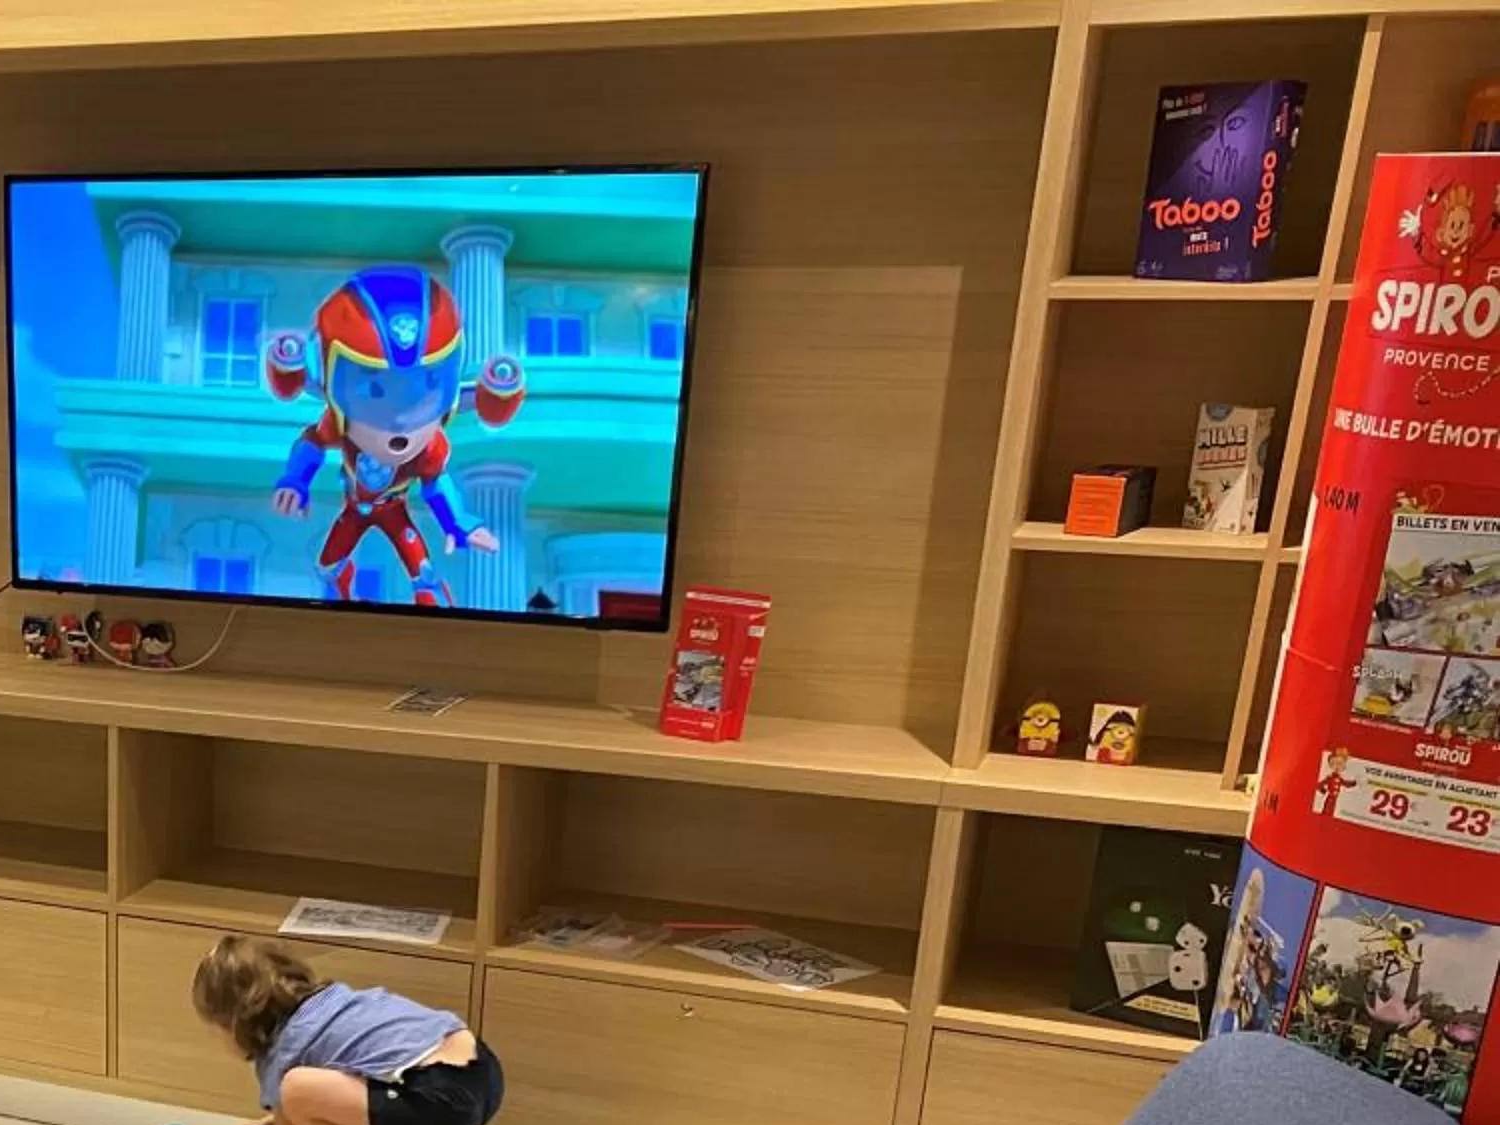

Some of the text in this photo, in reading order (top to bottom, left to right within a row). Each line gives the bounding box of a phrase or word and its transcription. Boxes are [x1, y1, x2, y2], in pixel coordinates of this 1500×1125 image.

[1148, 197, 1240, 230] Taboo
[1251, 150, 1277, 248] Taboo
[1383, 348, 1490, 372] PROVENCE
[1352, 412, 1403, 439] BULLE
[1397, 515, 1448, 529] BILLETS
[1451, 519, 1469, 531] EN
[1414, 743, 1472, 766] SPIROU
[1369, 789, 1410, 820] 29
[1446, 805, 1491, 837] 23
